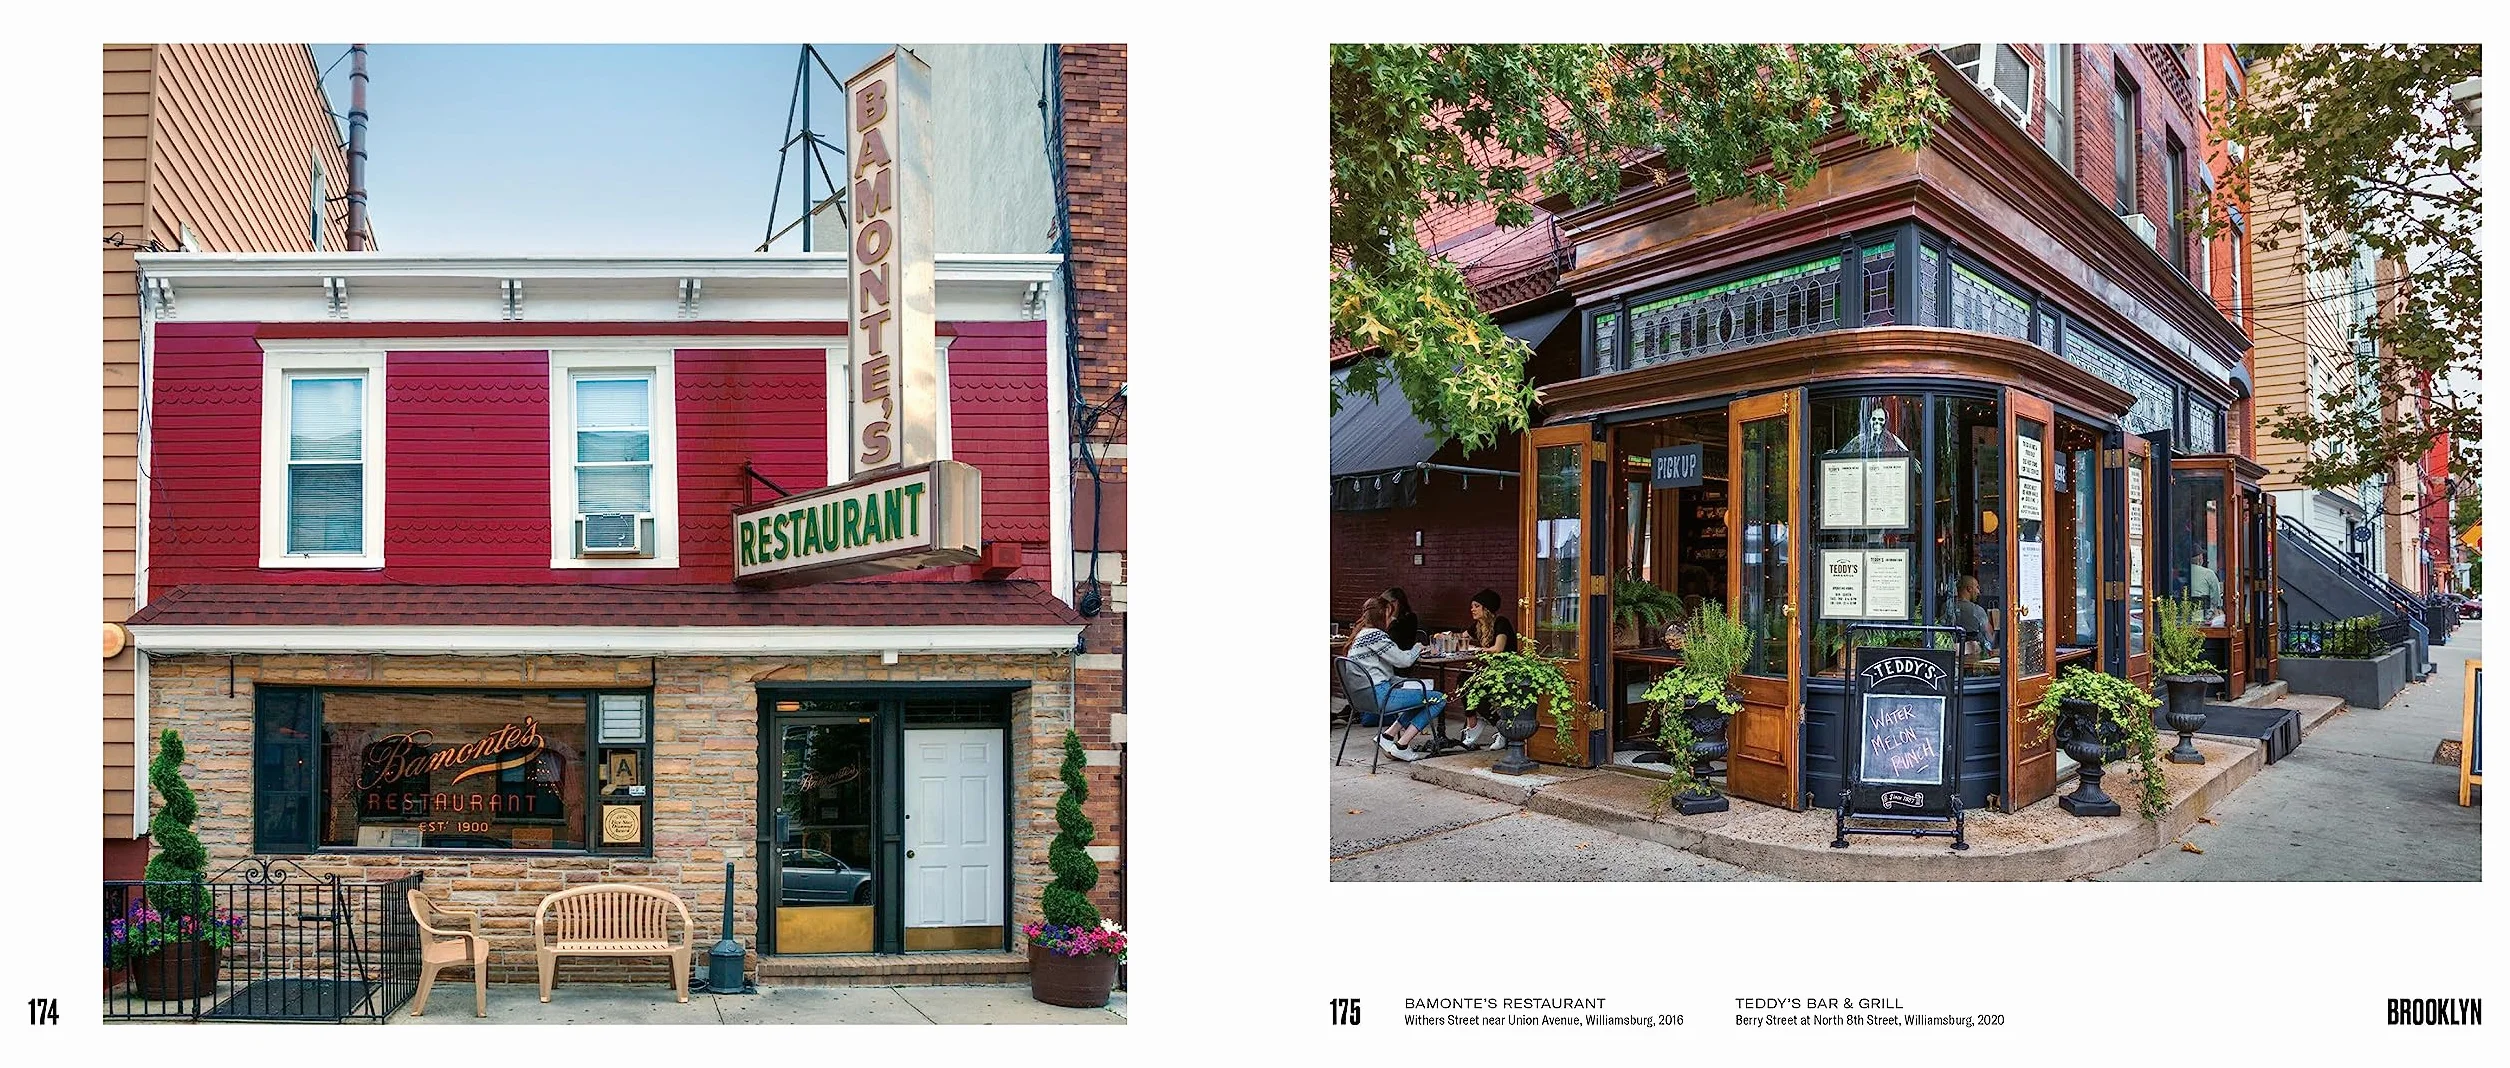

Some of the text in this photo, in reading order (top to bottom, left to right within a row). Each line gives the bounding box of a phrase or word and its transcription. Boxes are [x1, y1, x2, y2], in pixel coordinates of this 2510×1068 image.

[854, 78, 893, 465] BAMONTE'S
[740, 481, 926, 568] RESTAURANT
[1829, 564, 1858, 574] TEDDY'S
[1873, 659, 1936, 680] TEDDY'S
[1869, 704, 1916, 730] WATER
[356, 716, 545, 790] Bamonte's
[1870, 725, 1918, 757] MELON
[616, 758, 633, 777] A
[1890, 737, 1936, 778] PUNCH
[799, 763, 861, 793] Bamonte's
[368, 792, 537, 812] RESTAURANT
[457, 821, 489, 832] 1900
